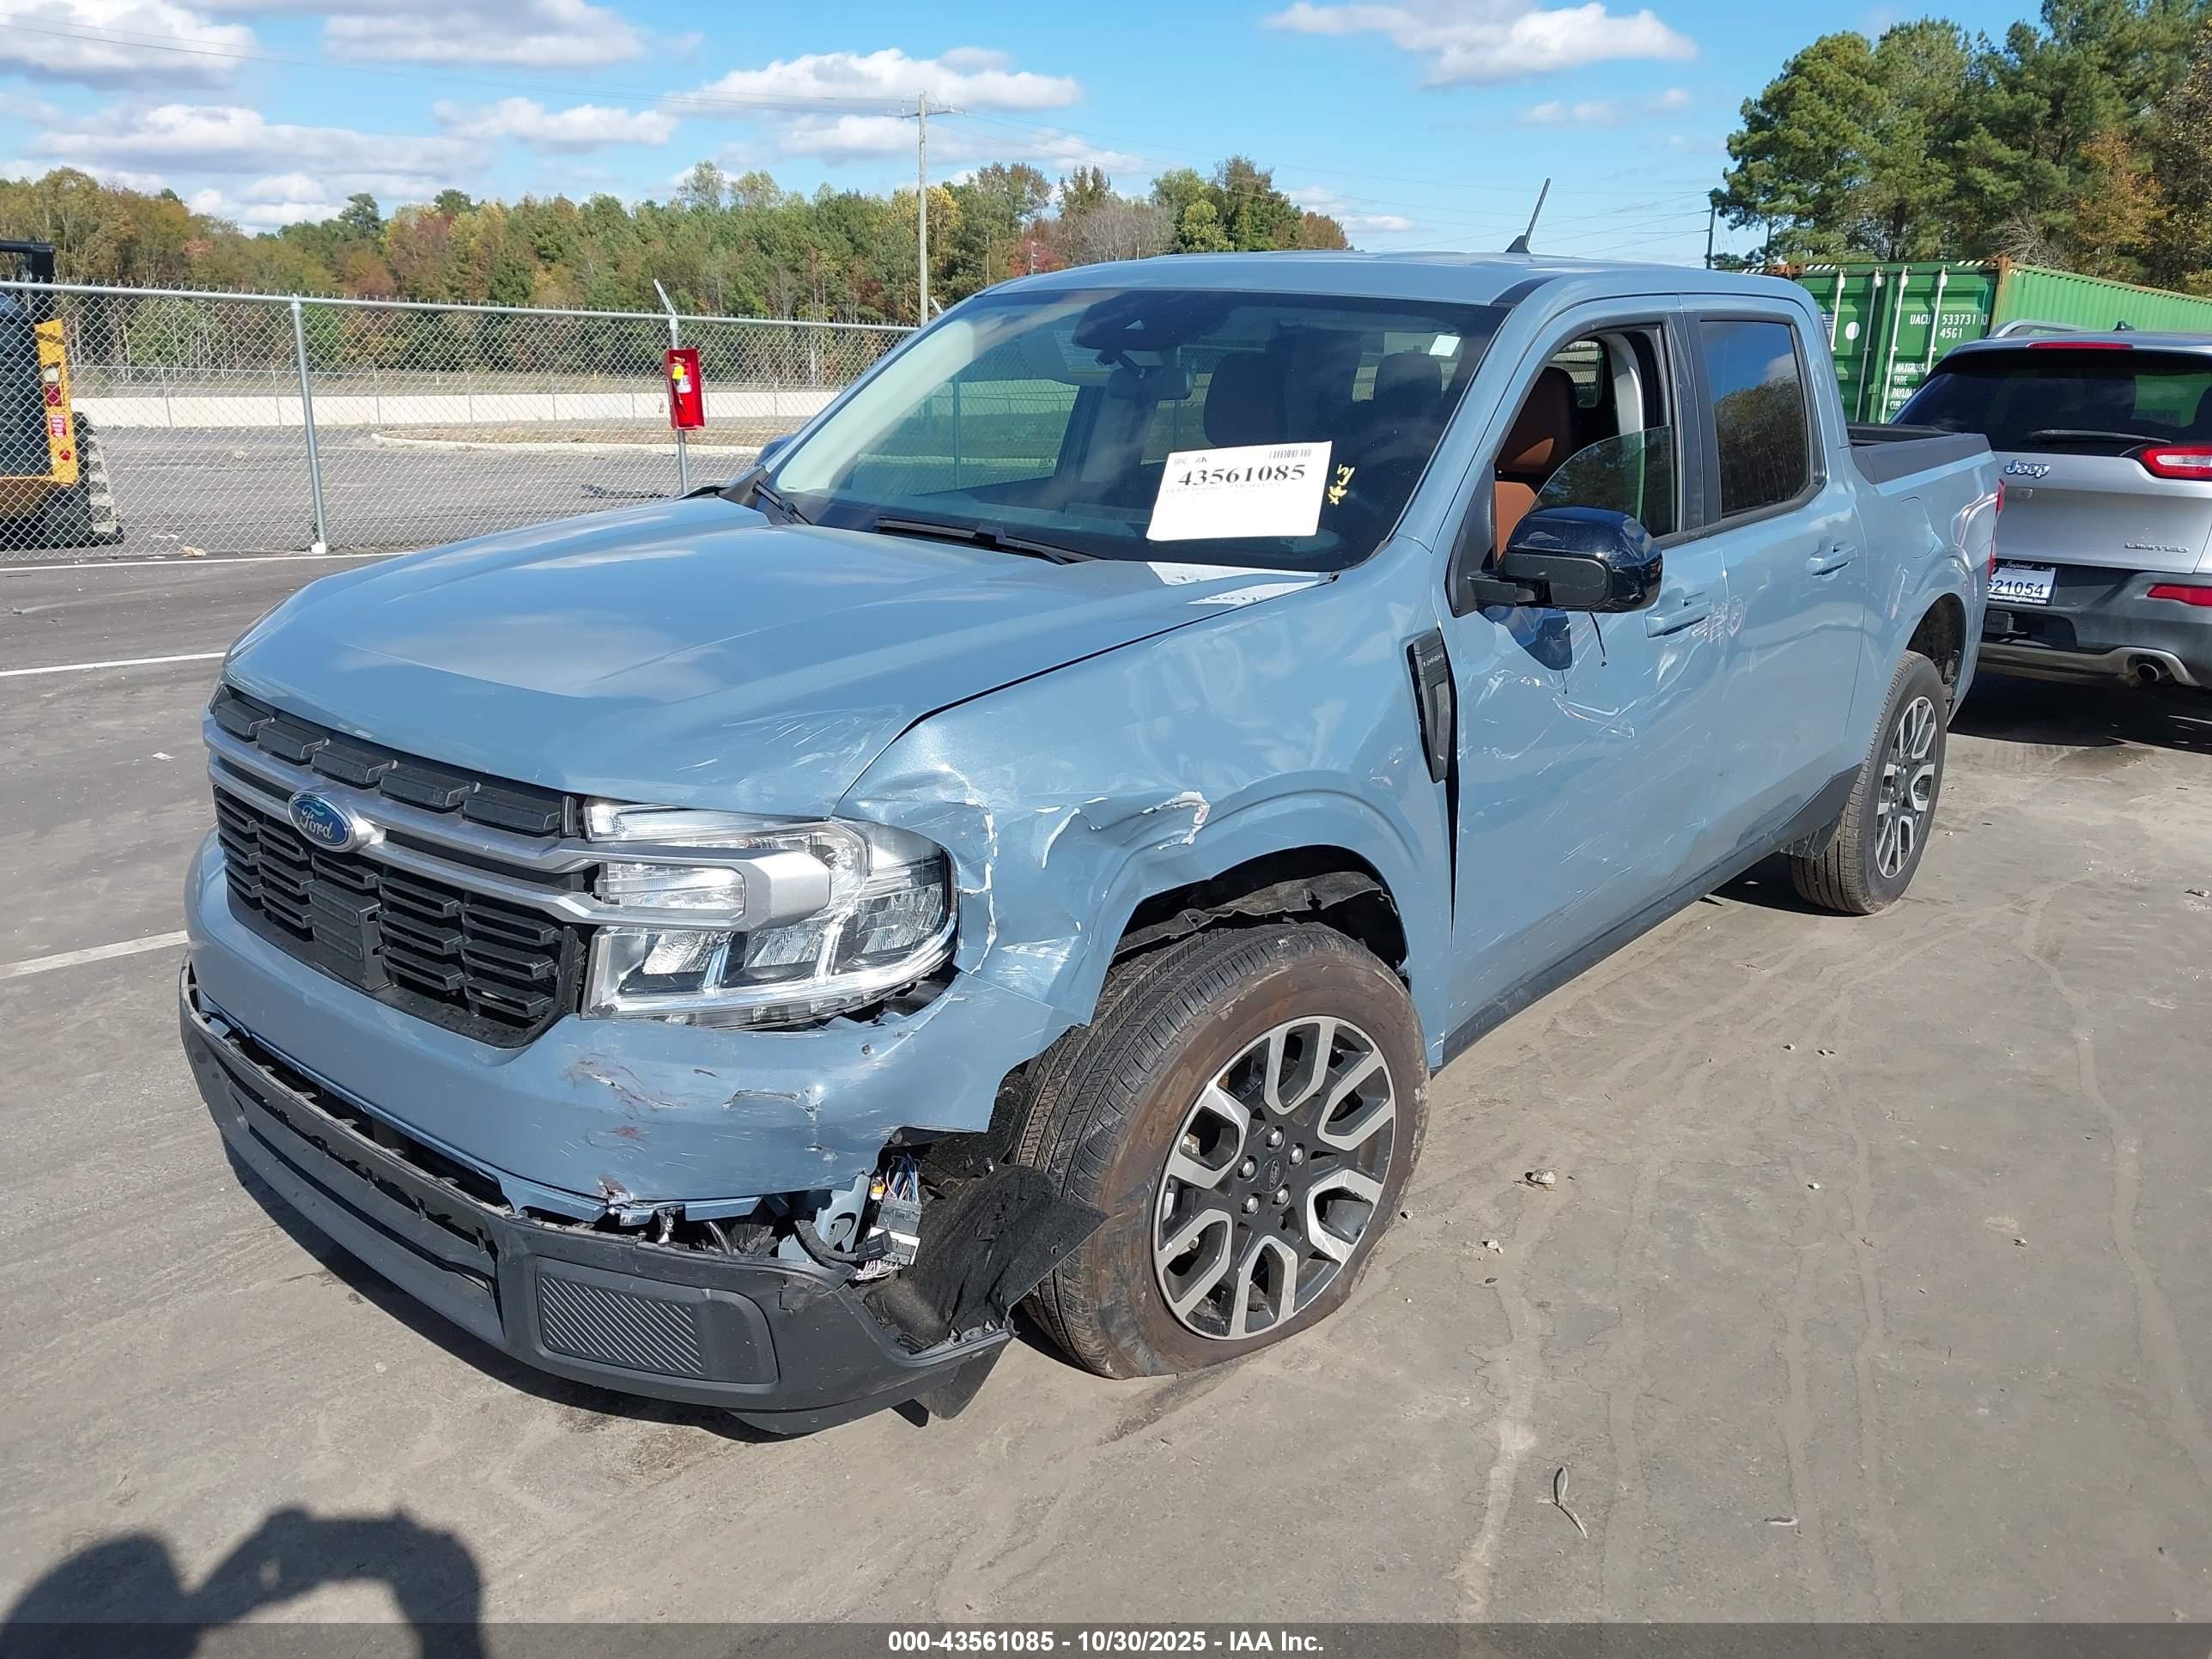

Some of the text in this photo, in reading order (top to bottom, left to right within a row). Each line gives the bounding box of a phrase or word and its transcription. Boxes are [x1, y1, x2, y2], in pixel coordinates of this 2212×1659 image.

[1910, 314, 1931, 325] UACU
[1942, 314, 1977, 325] 533731
[1940, 328, 1963, 338] 45G1
[1893, 375, 1908, 386] TARE
[2005, 459, 2050, 478] Jeep
[1177, 464, 1306, 486] 43561085
[2124, 543, 2189, 553] LIMITED
[300, 805, 333, 839] Ford
